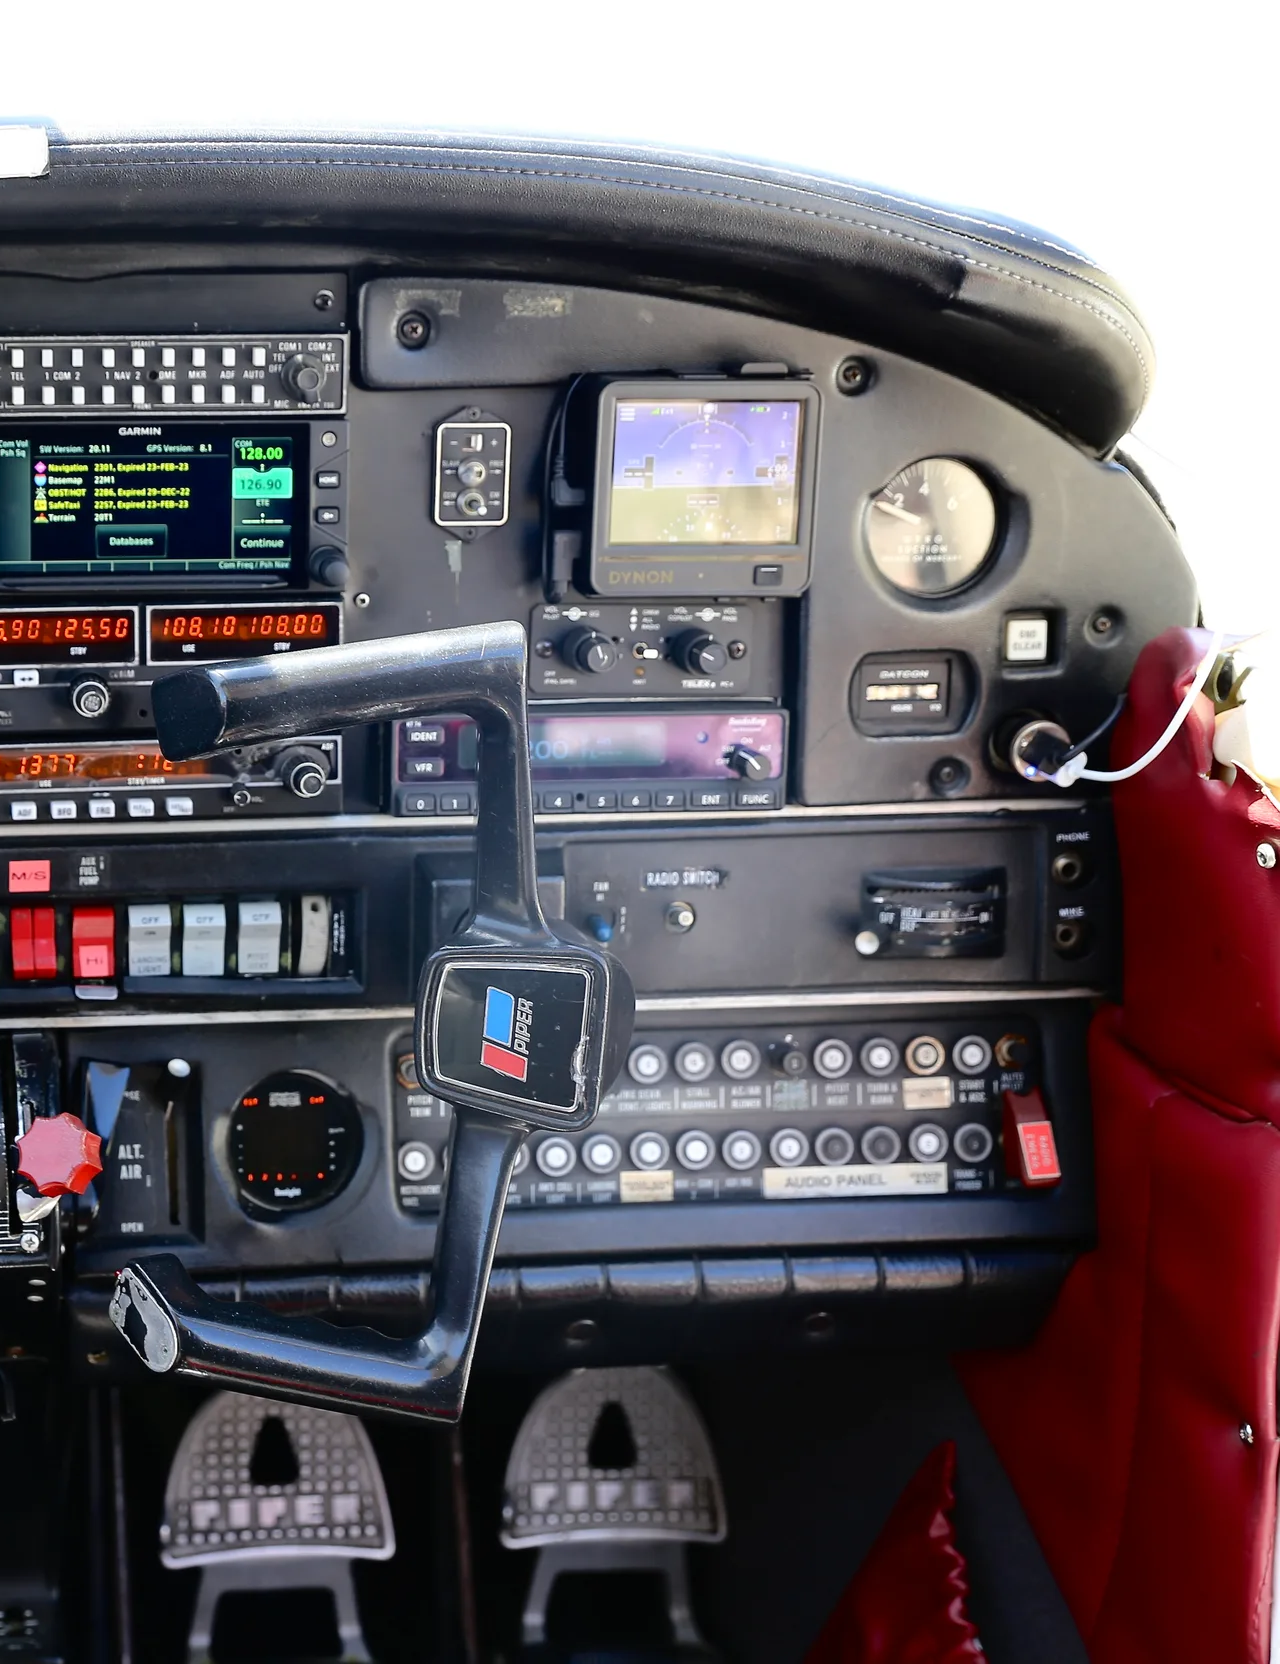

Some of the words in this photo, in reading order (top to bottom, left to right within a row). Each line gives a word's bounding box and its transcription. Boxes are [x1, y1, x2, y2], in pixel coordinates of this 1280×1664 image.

[10, 371, 25, 381] TEL
[243, 370, 265, 380] AUTO
[118, 426, 162, 437] GARMIN
[239, 446, 284, 460] 128.00
[47, 463, 89, 474] Navigation
[116, 462, 146, 473] Expired
[146, 462, 189, 472] 23-FEB-23
[240, 479, 283, 491] 126.90
[109, 536, 154, 547] Databases
[240, 537, 285, 549] Continue
[608, 569, 674, 585] DYNON
[55, 618, 128, 640] 125.50
[163, 615, 236, 638] 108.10
[250, 614, 323, 636] 108.00
[70, 647, 88, 656] STBY
[878, 669, 930, 680] DATCON
[410, 731, 438, 742] IDENT
[20, 754, 76, 775] 1377
[415, 762, 434, 773] VFR
[554, 797, 563, 808] 4
[597, 796, 606, 807] 5
[632, 795, 640, 806] 6
[666, 795, 675, 806] 7
[701, 794, 721, 805] ENT
[741, 793, 770, 805] FUNC
[1056, 831, 1091, 843] PHONE
[80, 856, 97, 866] AUX
[11, 870, 47, 881] M/S
[78, 866, 99, 876] FUEL
[78, 876, 100, 887] PUMP
[646, 871, 680, 887] RADIO
[682, 870, 720, 886] SWITCH
[131, 954, 168, 964] LANDING
[137, 964, 162, 975] LIGHT
[513, 997, 534, 1056] PIPER
[118, 1144, 145, 1160] ALT.
[120, 1165, 142, 1180] AIR
[784, 1174, 831, 1189] AUDIO
[835, 1173, 887, 1188] PANEL
[190, 1491, 362, 1529] PIPER
